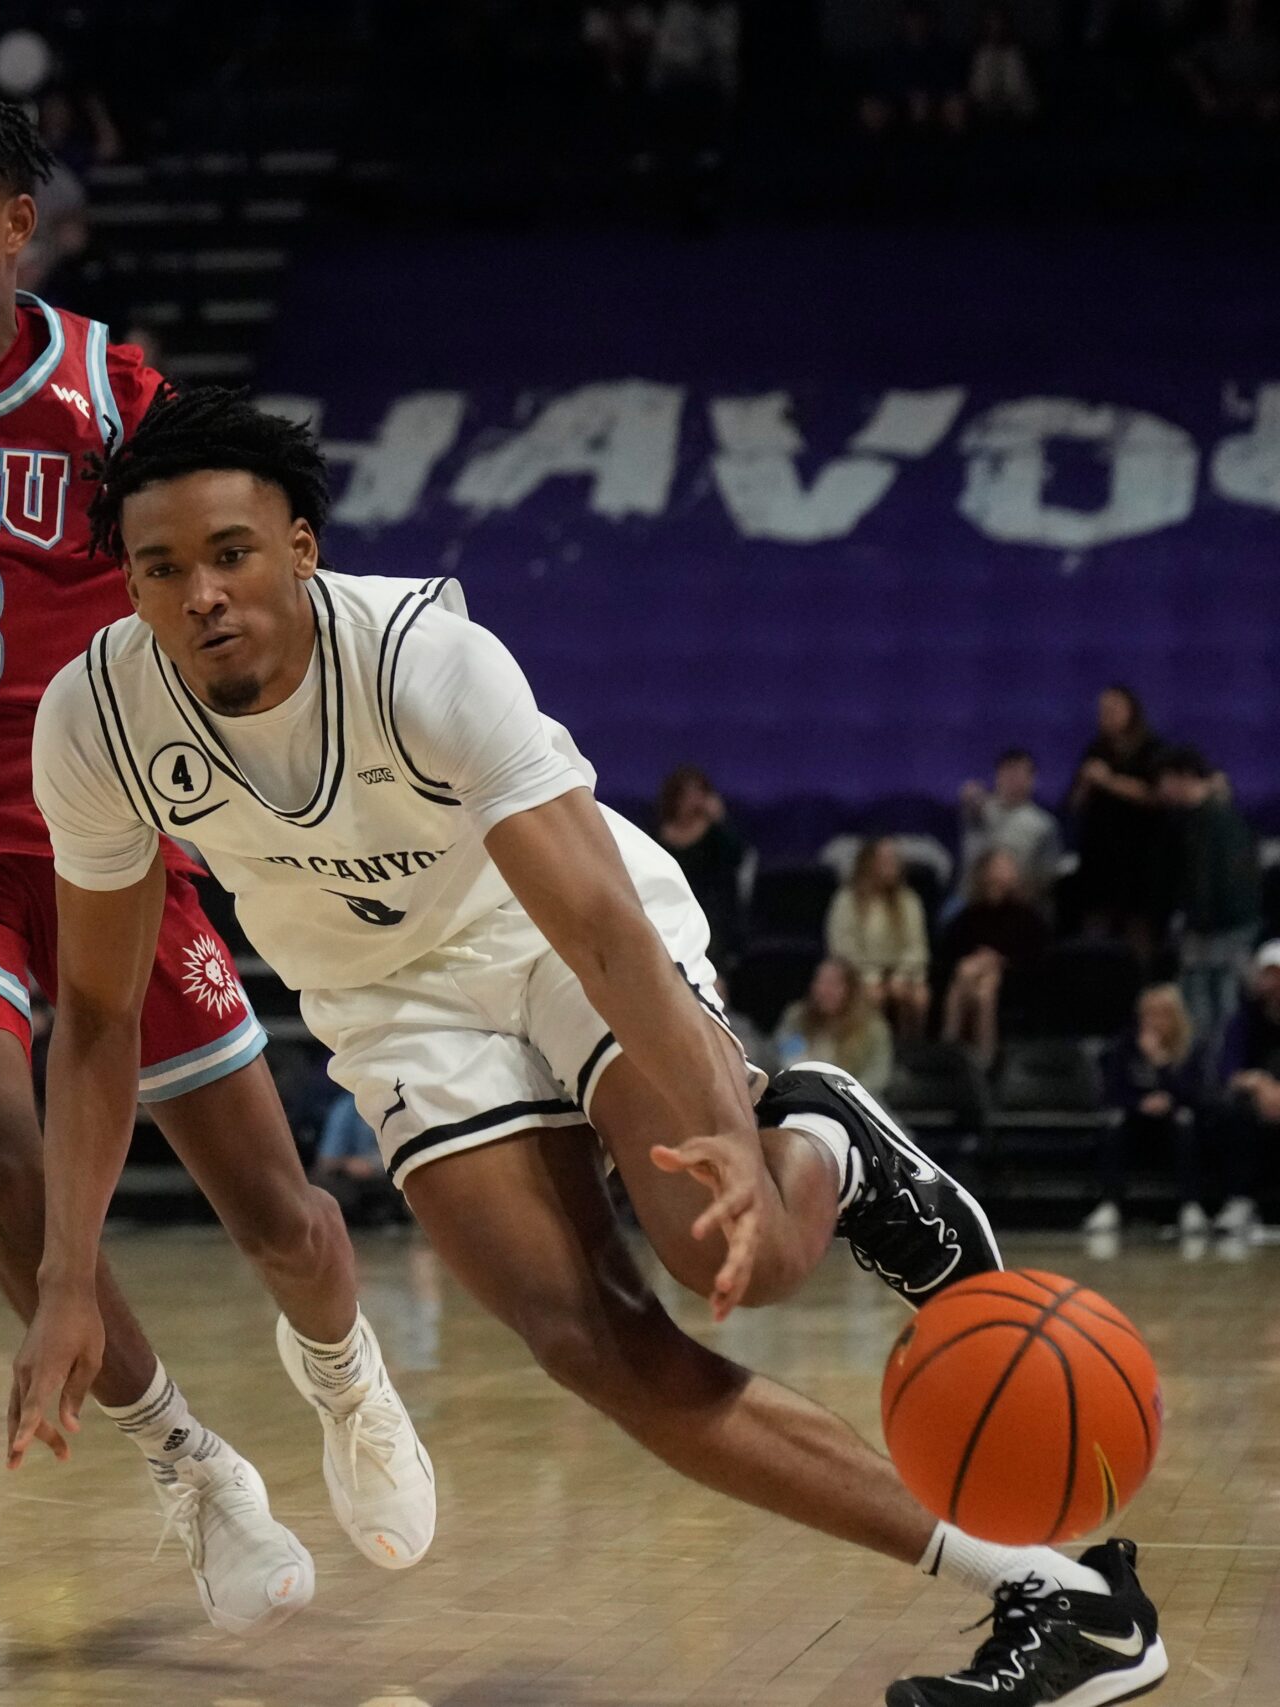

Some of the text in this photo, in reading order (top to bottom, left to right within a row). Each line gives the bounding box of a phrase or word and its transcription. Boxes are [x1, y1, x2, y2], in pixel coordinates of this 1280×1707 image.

[171, 754, 194, 792] 4
[358, 767, 395, 786] WAC
[307, 843, 456, 884] CANYO
